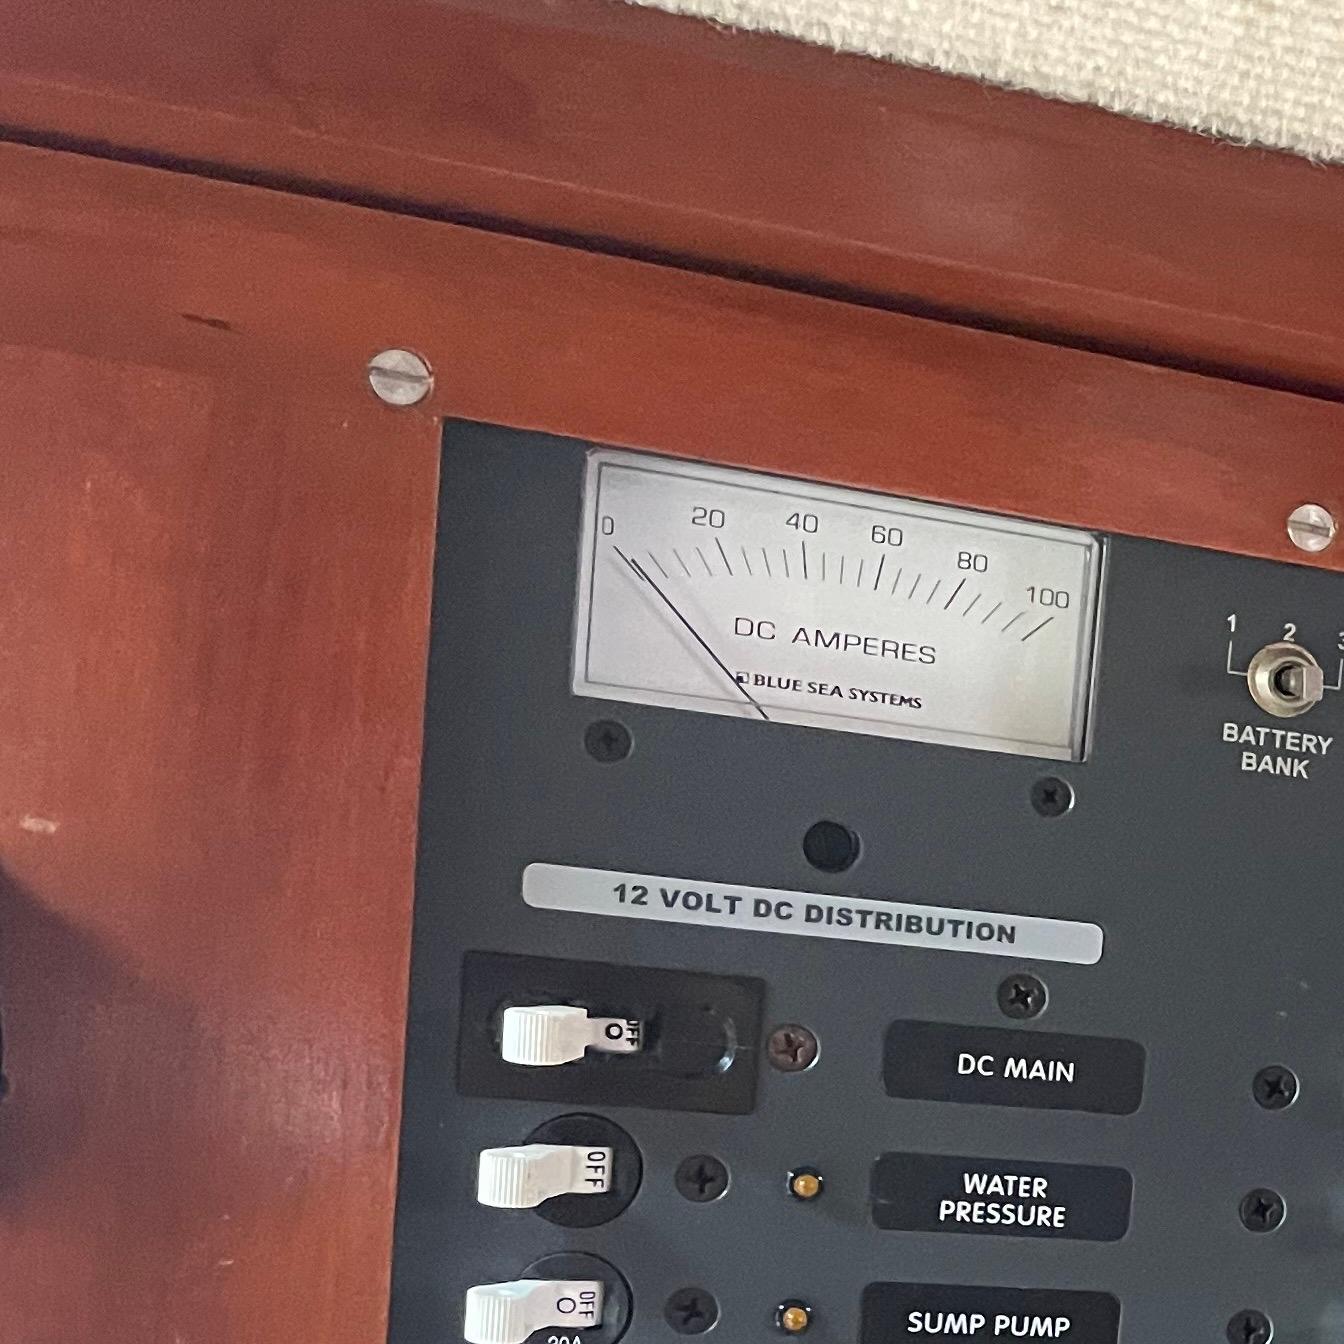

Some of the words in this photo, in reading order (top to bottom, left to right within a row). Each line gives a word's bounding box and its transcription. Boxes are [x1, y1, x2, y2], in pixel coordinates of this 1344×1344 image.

[602, 516, 615, 537] 0
[691, 506, 725, 529] 20
[785, 513, 818, 534] 40
[871, 525, 903, 547] 60
[958, 552, 989, 573] 80
[1026, 586, 1070, 609] 100
[1227, 614, 1237, 632] 1
[1283, 623, 1297, 642] 2
[735, 618, 776, 640] DC
[792, 628, 936, 665] AMPERES
[753, 674, 803, 693] BLUE
[808, 681, 843, 699] SEA
[848, 686, 923, 710] SYSTEMS
[1223, 723, 1333, 755] BATTERY
[1241, 752, 1309, 779] BANK
[613, 882, 649, 906] 12
[660, 888, 744, 916] VOLT
[753, 897, 793, 921] DC
[804, 904, 1017, 944] DISTRIBUTION
[957, 1053, 994, 1077] DC
[1003, 1059, 1076, 1084] MAIN
[584, 1150, 606, 1189] OFF
[963, 1173, 1048, 1198] WATER
[938, 1200, 1066, 1228] PRESSURE
[578, 1290, 596, 1321] OFF
[907, 1311, 985, 1336] SUMP
[993, 1315, 1071, 1338] PUMP
